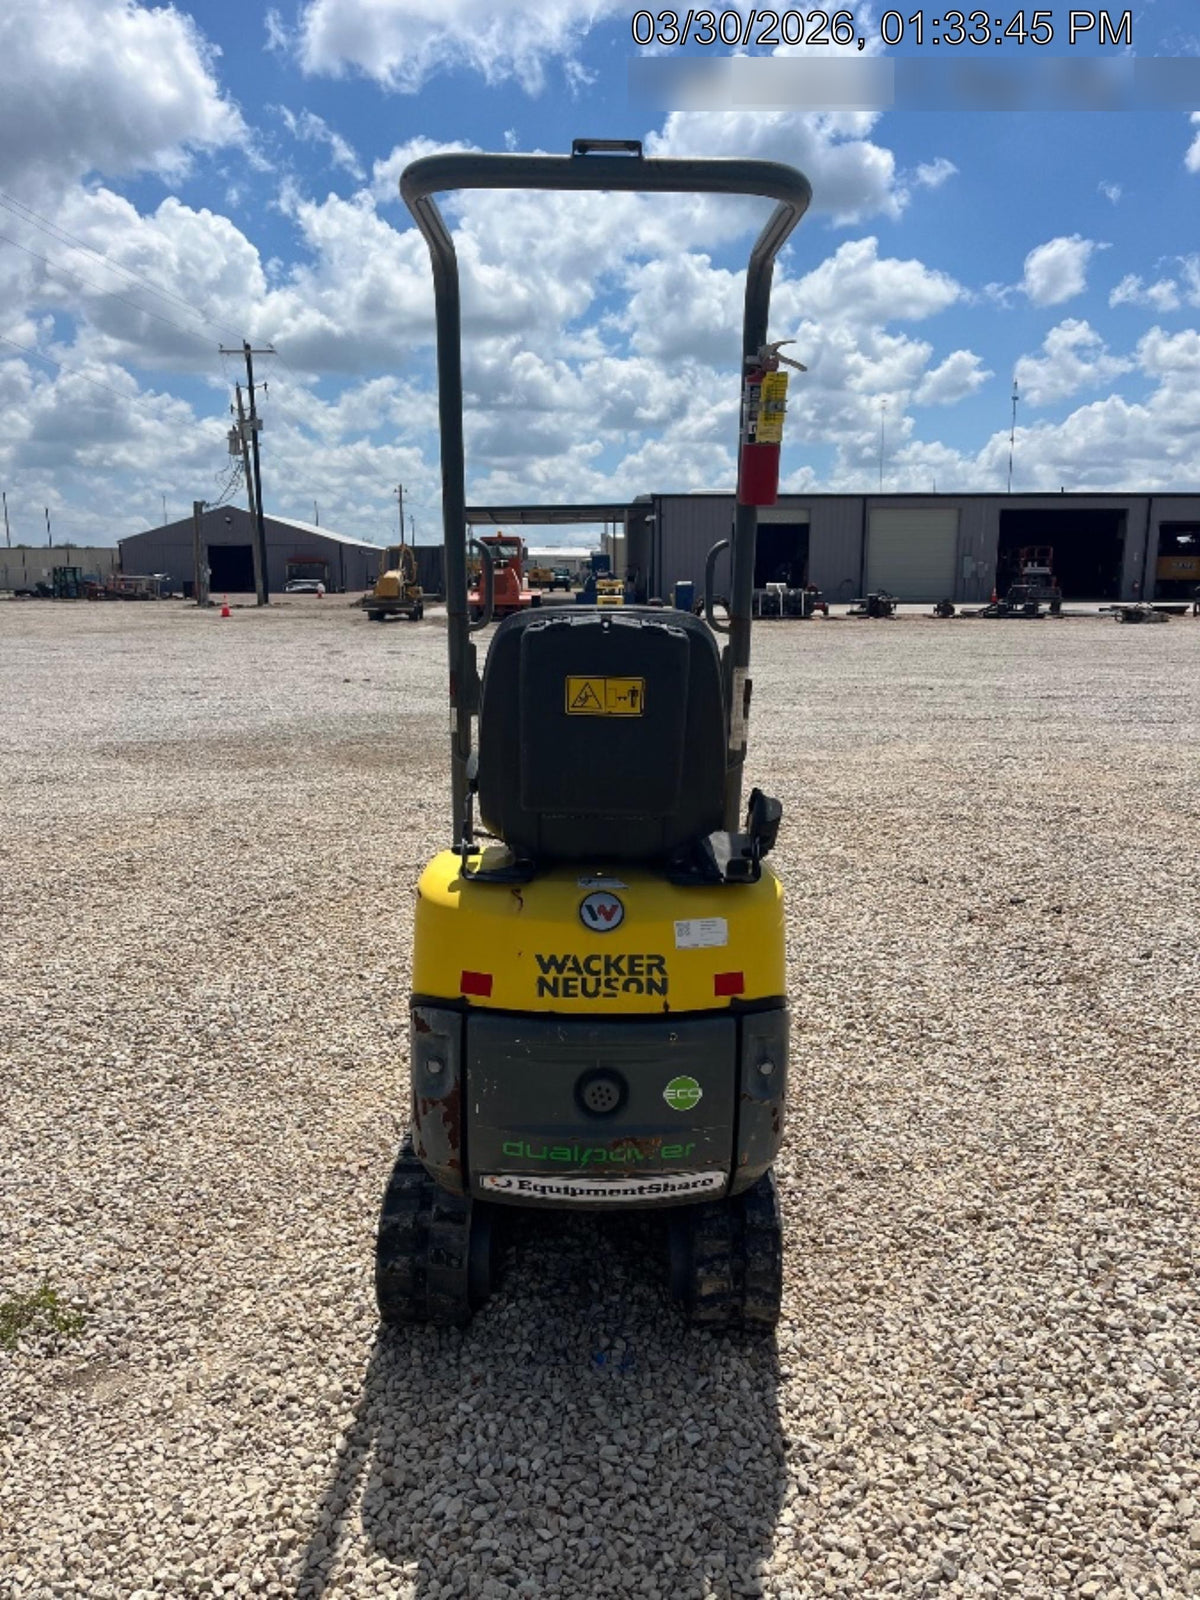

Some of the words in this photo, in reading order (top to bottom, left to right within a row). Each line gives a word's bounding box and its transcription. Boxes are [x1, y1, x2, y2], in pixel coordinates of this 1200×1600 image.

[534, 953, 669, 976] WACKER
[536, 976, 669, 998] NEUSON
[663, 1088, 703, 1100] ECO
[518, 1178, 714, 1198] EquipmentShare
